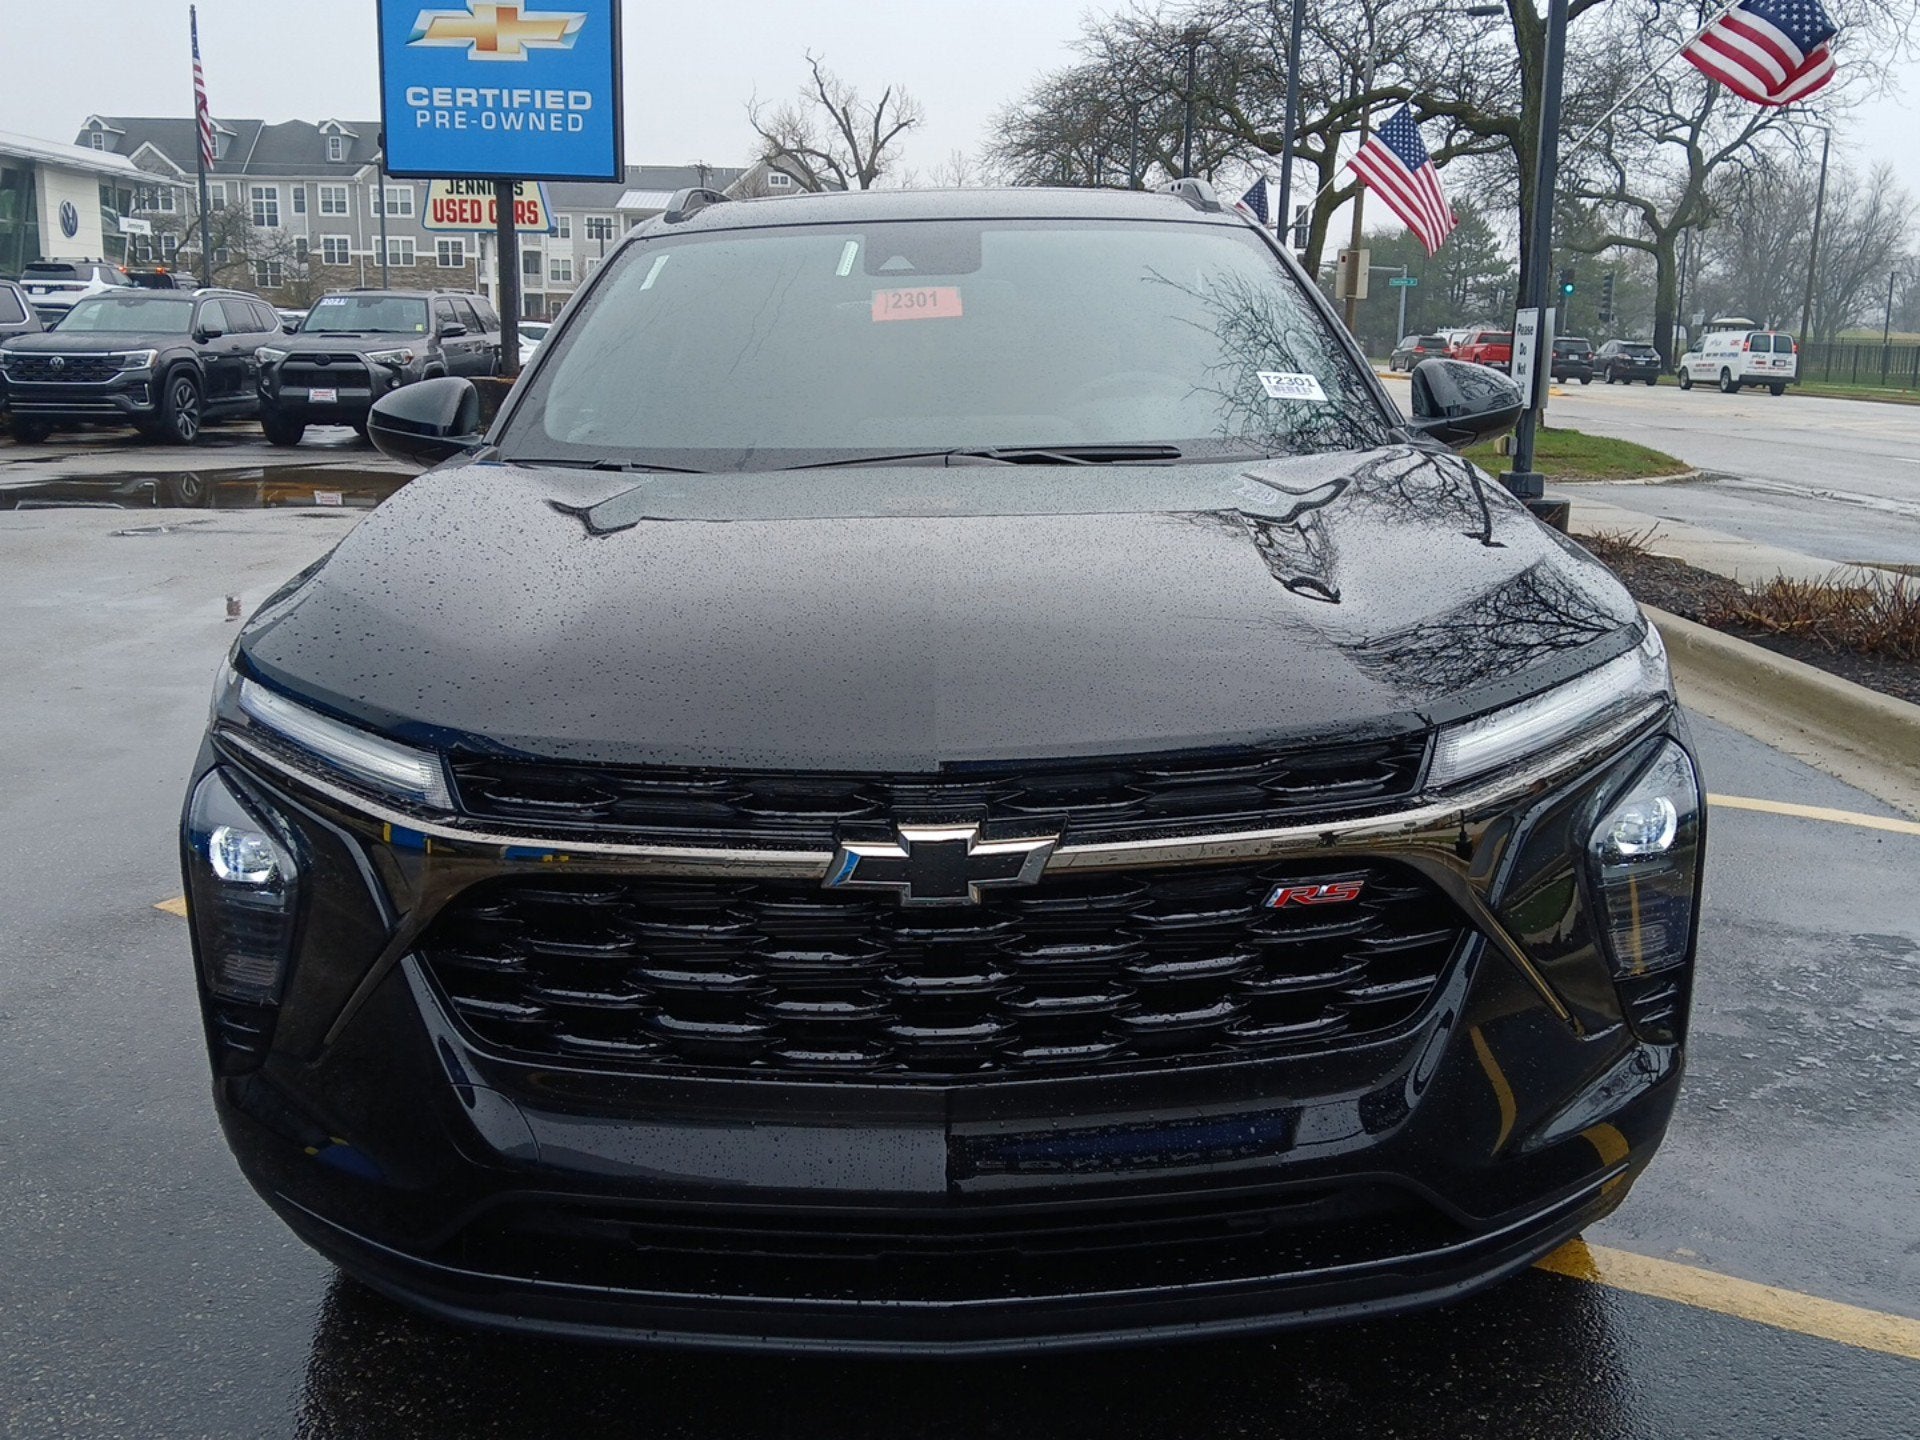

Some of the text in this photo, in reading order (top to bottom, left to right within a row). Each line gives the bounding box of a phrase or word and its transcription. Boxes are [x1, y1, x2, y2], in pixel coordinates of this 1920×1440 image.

[405, 86, 592, 111] CERTIFIED
[416, 110, 583, 132] PRE-OWNED
[445, 180, 524, 196] JENNIS
[433, 199, 538, 225] USED CRS
[1519, 342, 1527, 356] Do
[1262, 375, 1316, 388] T2301
[1266, 880, 1364, 908] RS
